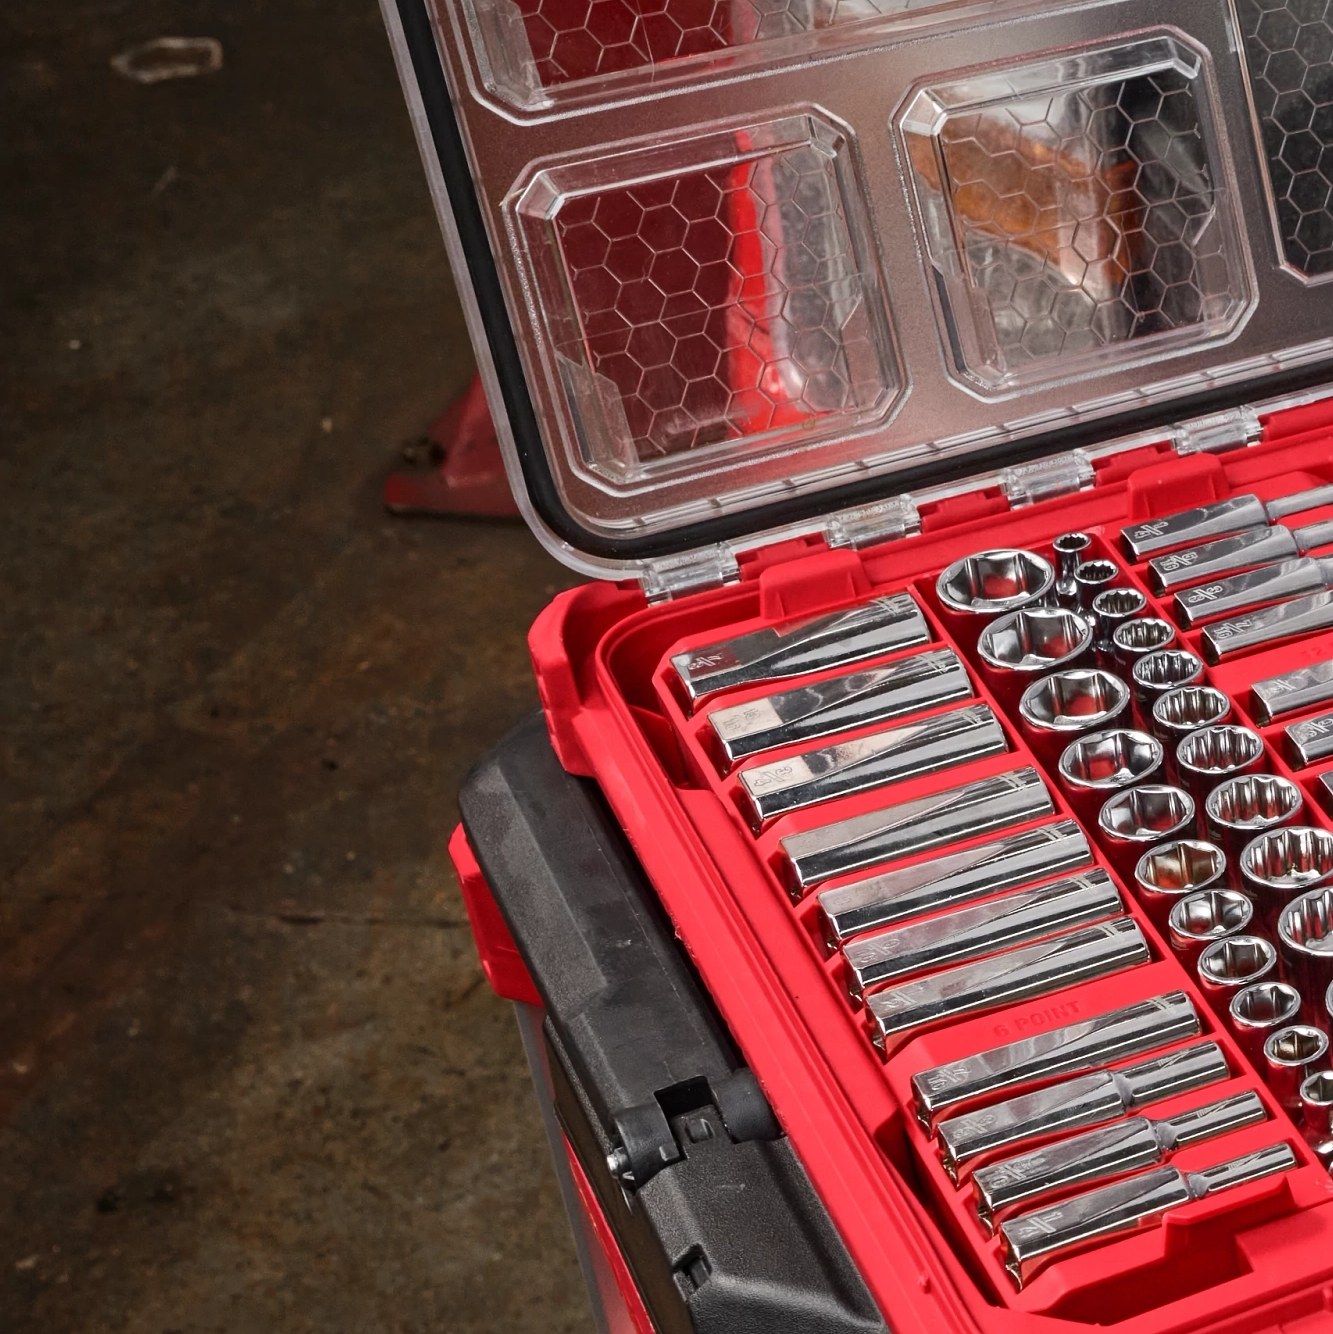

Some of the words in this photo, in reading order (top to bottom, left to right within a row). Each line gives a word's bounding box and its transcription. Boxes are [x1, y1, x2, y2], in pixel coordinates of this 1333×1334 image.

[1160, 551, 1199, 571] 5/16
[993, 1023, 1010, 1037] 6
[1014, 1001, 1080, 1031] POINT
